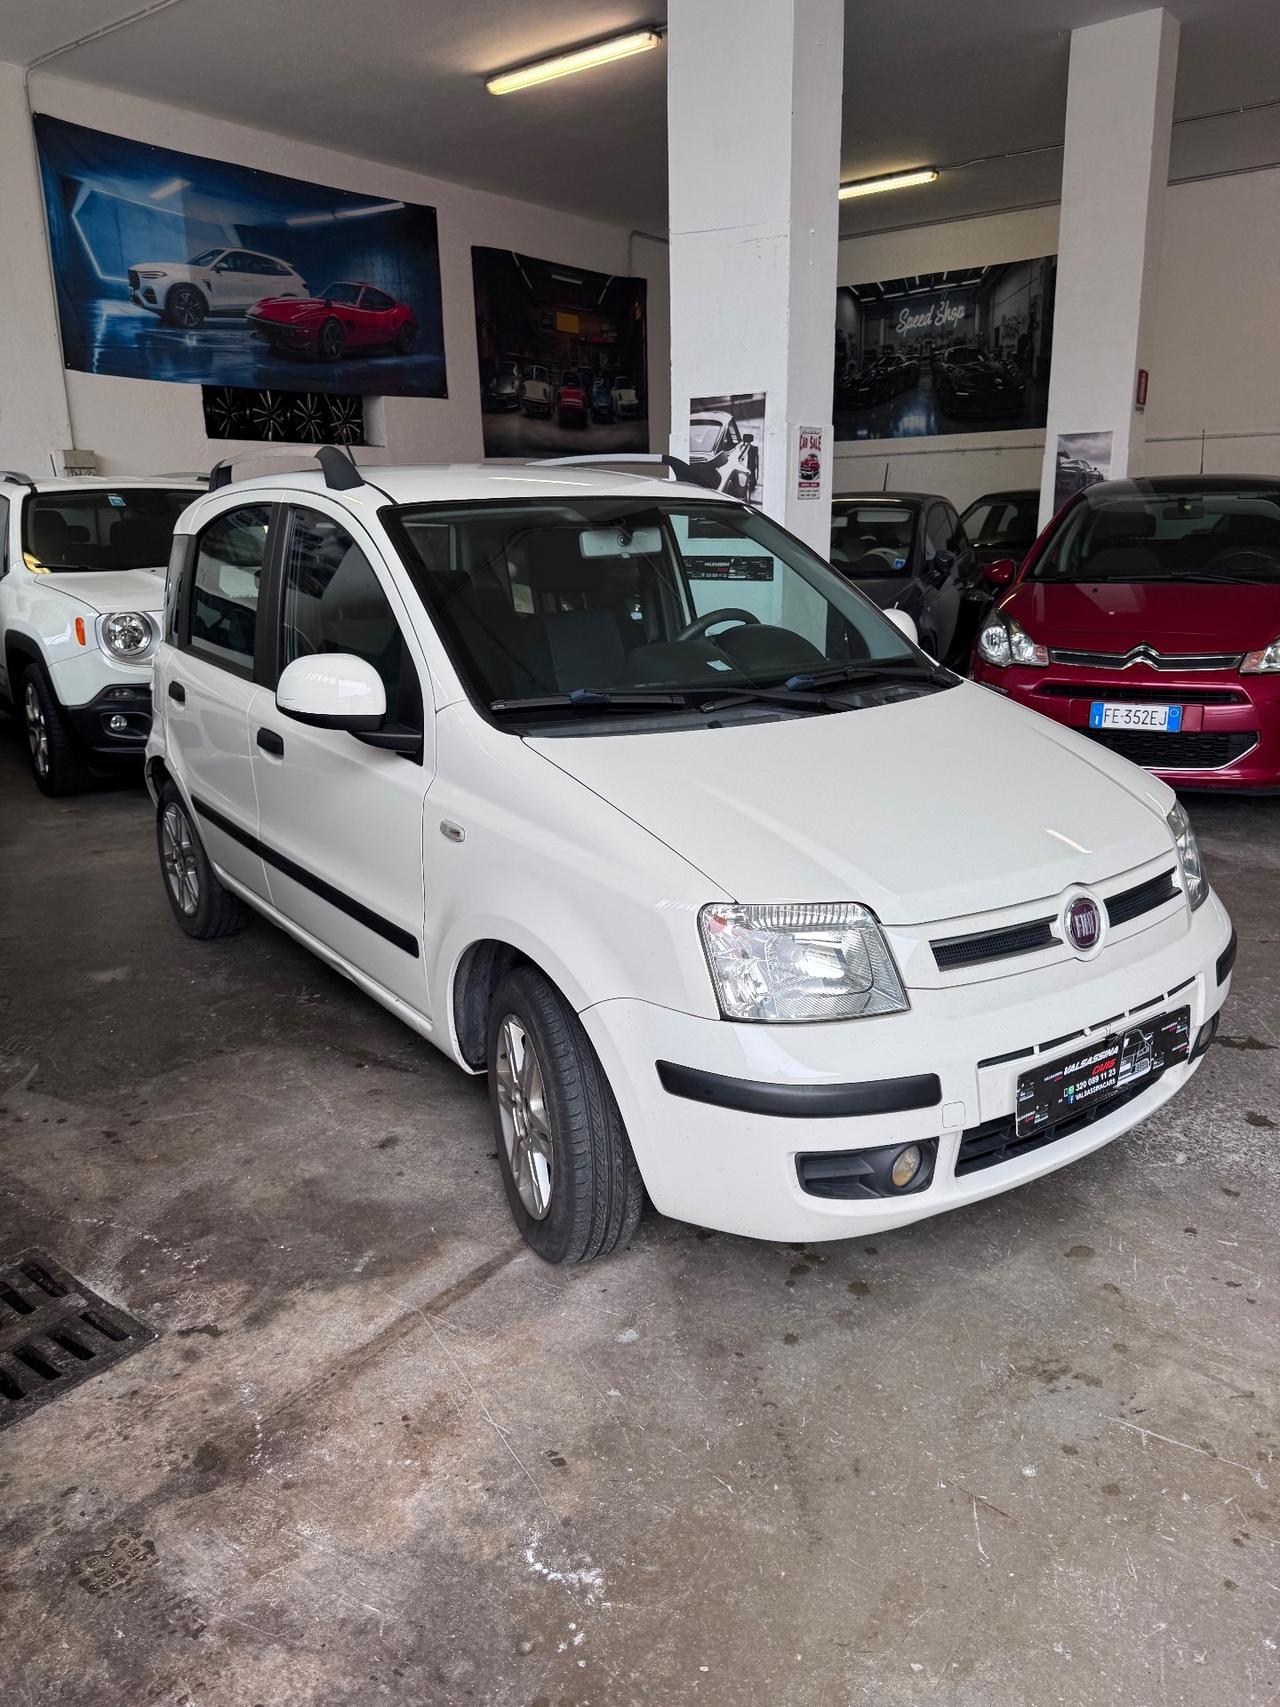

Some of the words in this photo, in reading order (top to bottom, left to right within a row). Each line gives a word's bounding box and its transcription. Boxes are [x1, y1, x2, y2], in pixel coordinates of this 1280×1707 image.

[896, 304, 935, 338] Speed
[934, 301, 966, 328] Shop
[1074, 910, 1095, 938] FIAT
[1091, 1058, 1117, 1077] CARS
